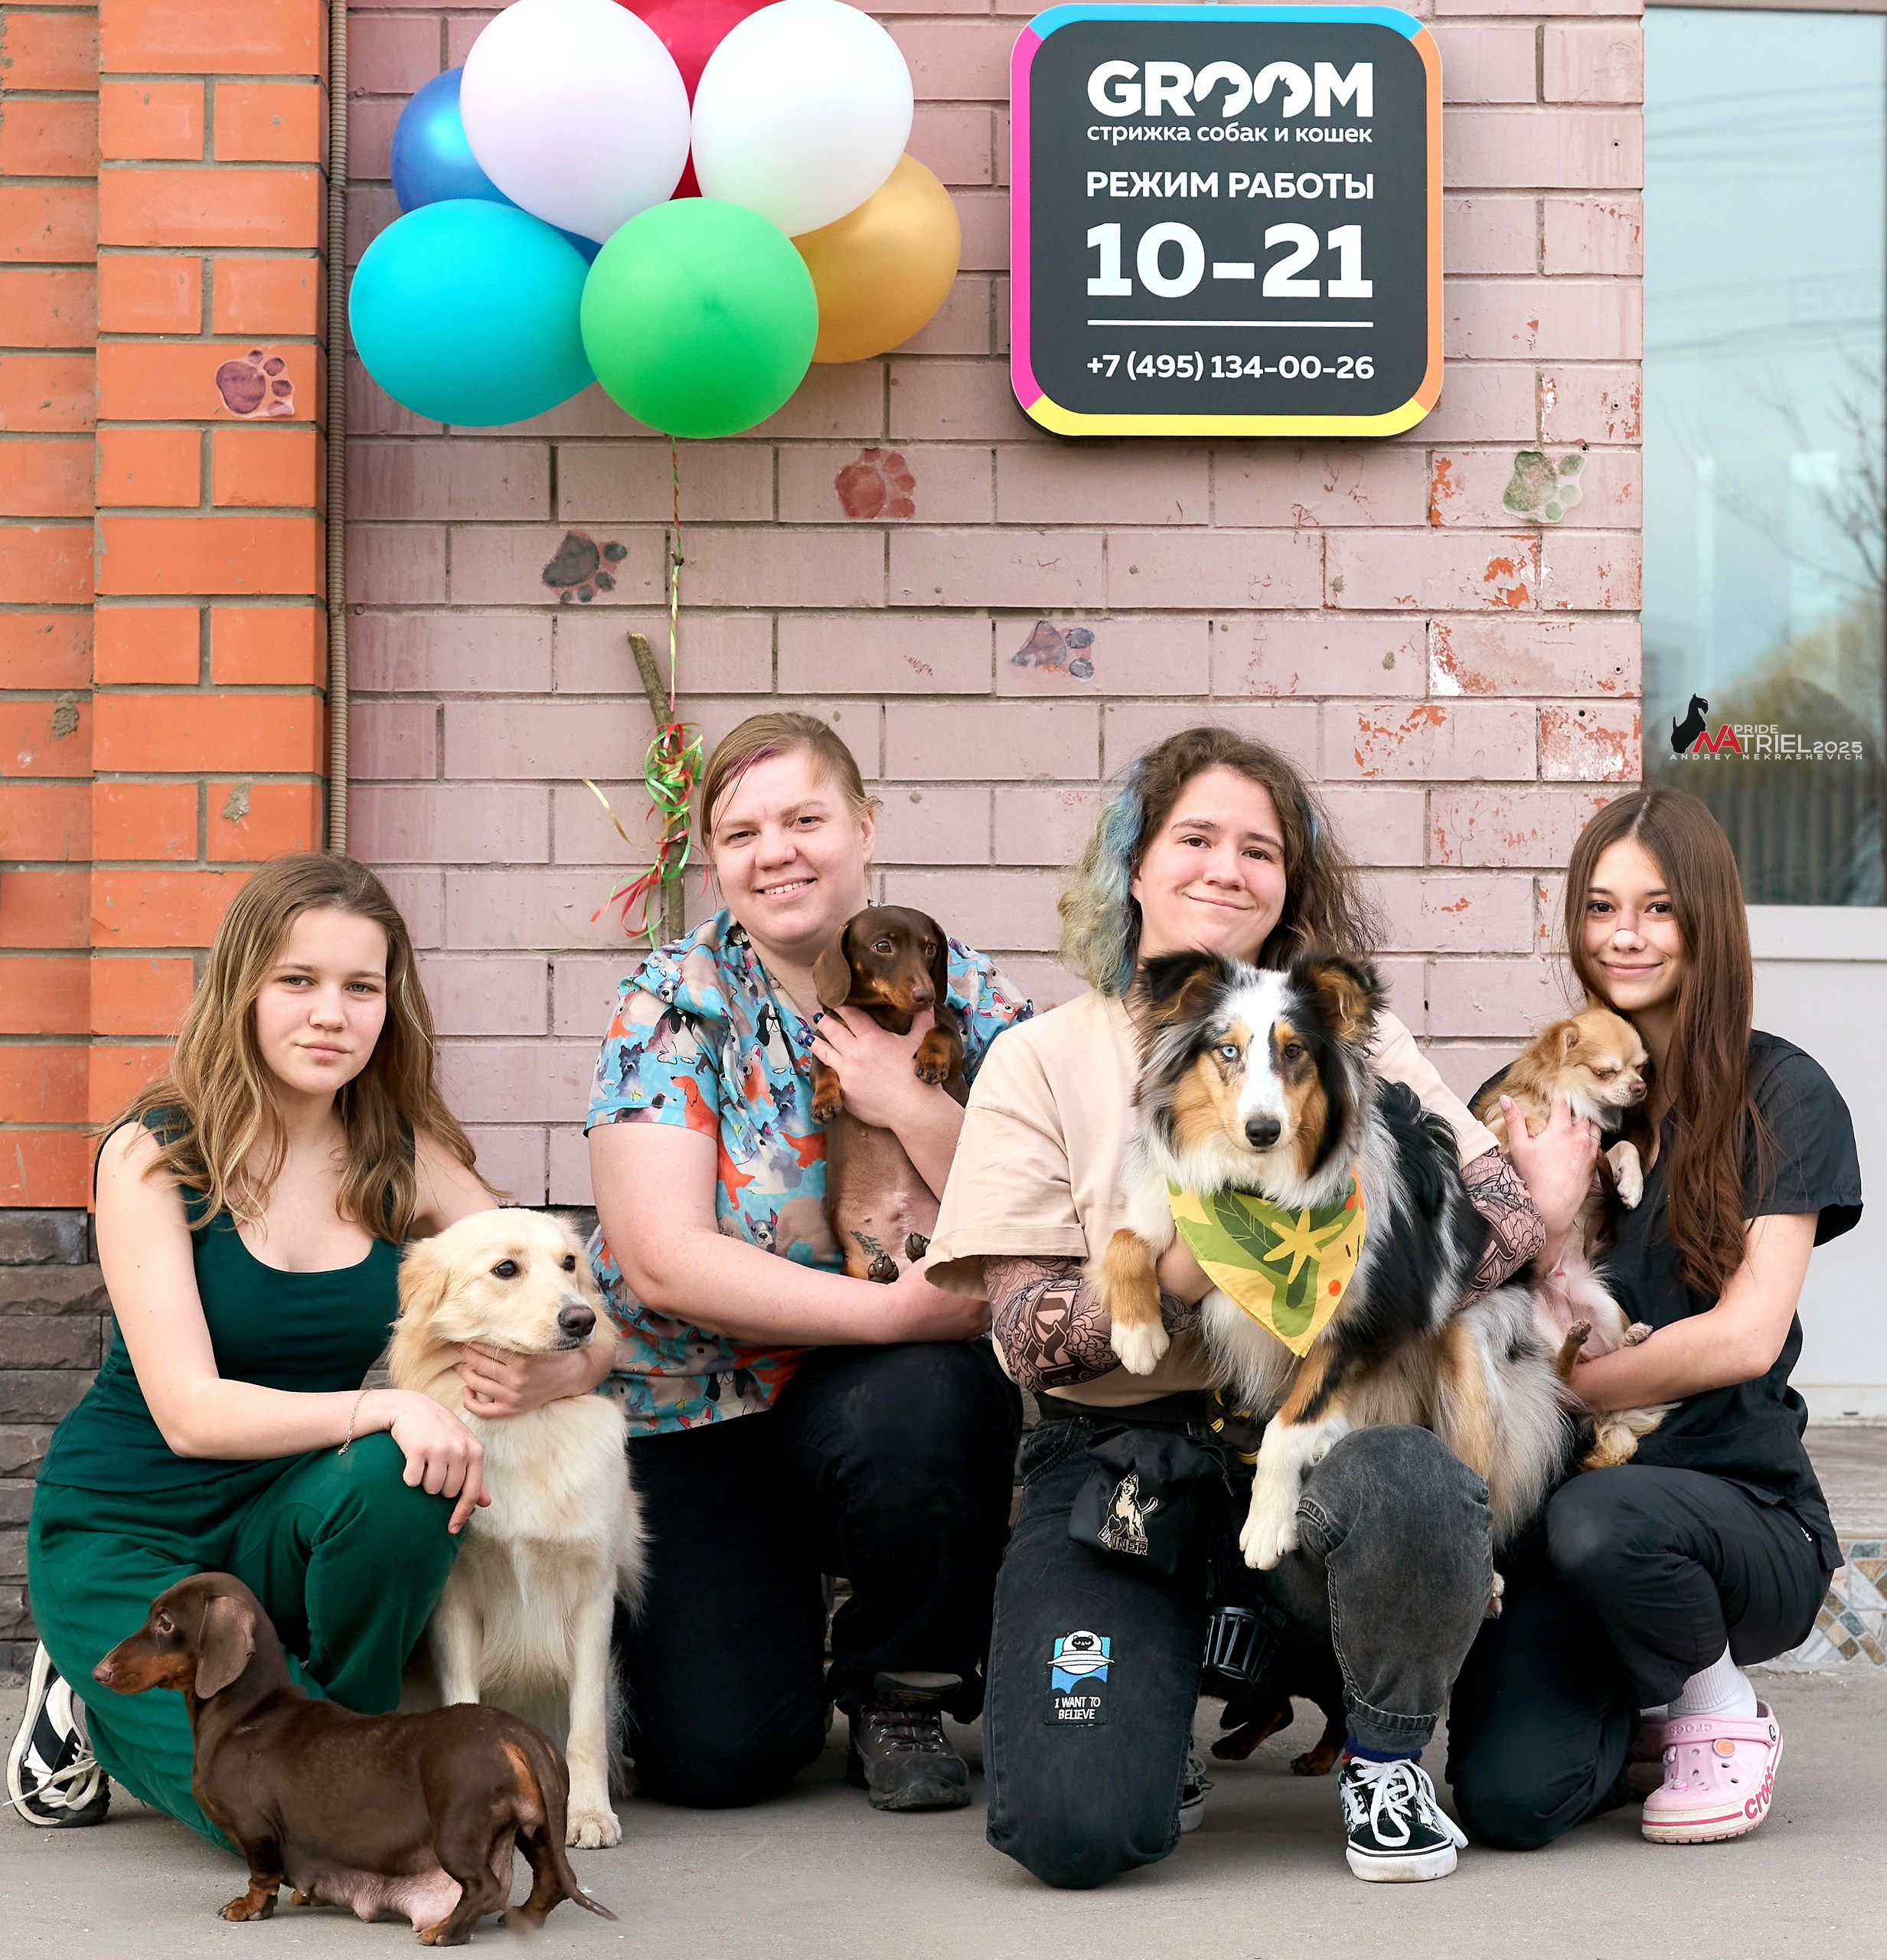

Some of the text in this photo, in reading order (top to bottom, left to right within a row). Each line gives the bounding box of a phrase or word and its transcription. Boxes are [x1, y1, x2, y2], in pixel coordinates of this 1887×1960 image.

[1086, 60, 1374, 118] GROOM
[1086, 121, 1373, 146] стрижка собак и кошек
[1086, 171, 1375, 200] РЕЖИМ РАБОТЫ
[1086, 351, 1376, 381] +7 (495) 134-00-26
[1054, 1696, 1102, 1709] I WANT TO
[1058, 1708, 1096, 1720] BELIEVE
